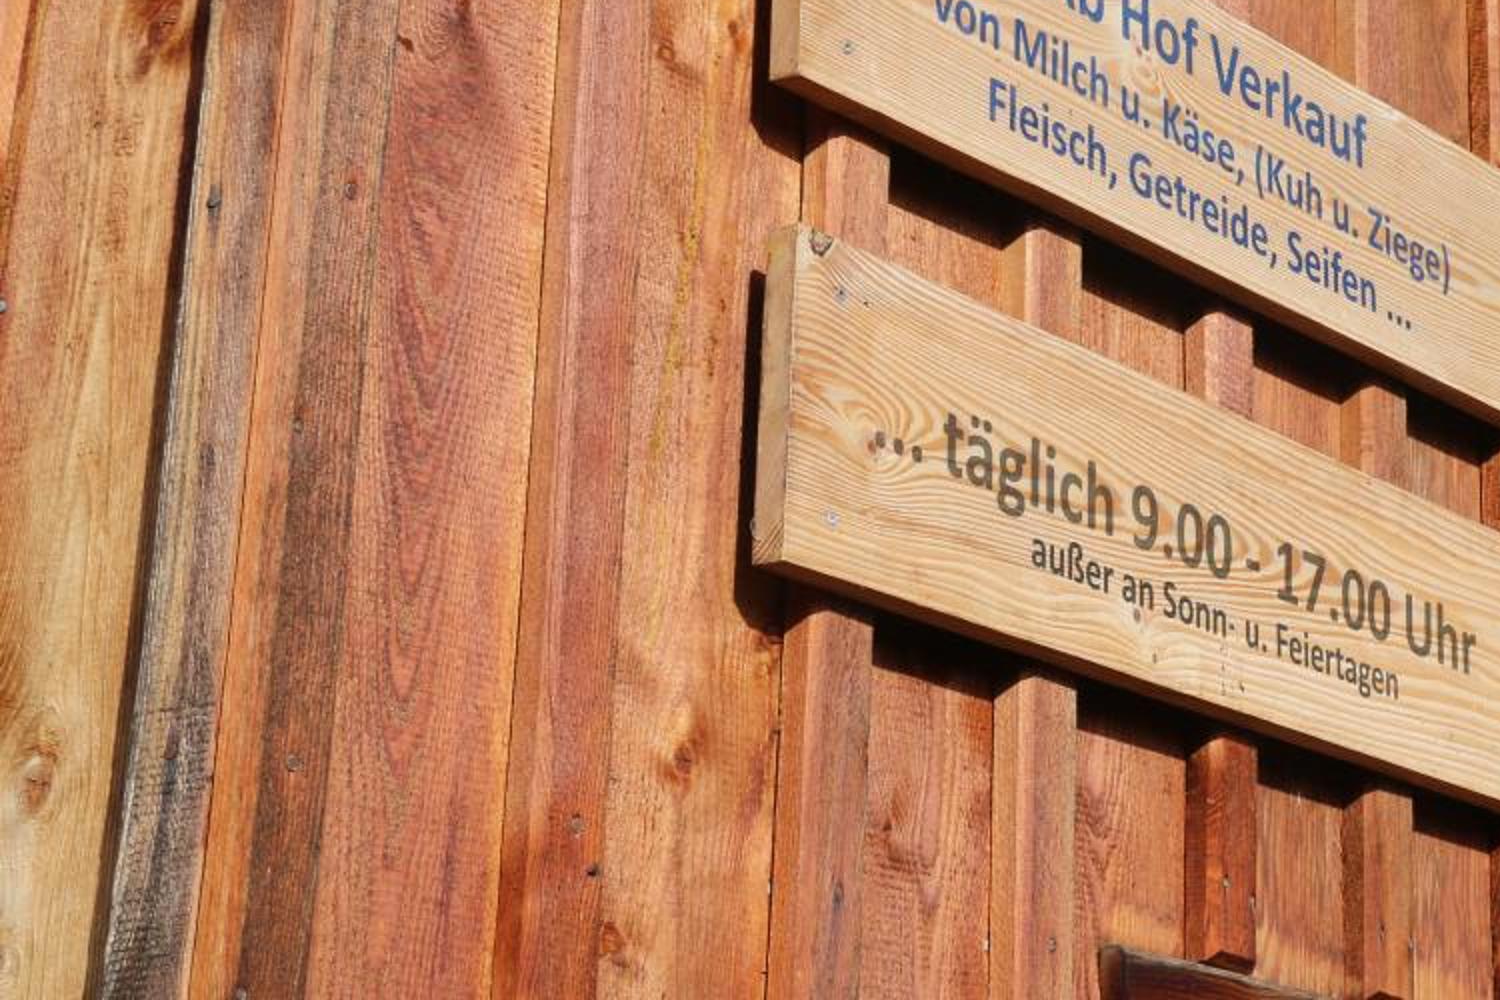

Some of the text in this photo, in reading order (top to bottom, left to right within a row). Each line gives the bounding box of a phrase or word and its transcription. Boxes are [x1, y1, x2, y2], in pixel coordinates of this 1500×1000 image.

[988, 77, 1117, 191] Fleisch,
[1129, 152, 1278, 269] Getreide,
[1287, 232, 1377, 313] Seifen
[1013, 18, 1109, 107] Milch
[1121, 98, 1151, 129] u.
[1163, 98, 1244, 187] Käse,
[1254, 144, 1324, 221] (Kuh
[1333, 199, 1359, 239] u.
[1368, 206, 1453, 296] Ziege)
[1212, 34, 1368, 169] Verkauf
[943, 411, 1115, 537] täglich
[1132, 484, 1233, 579] 9.00
[1275, 541, 1392, 642] 17.00
[1405, 593, 1477, 675] Uhr
[1030, 536, 1400, 700] außer an Sonn- u. Feiertagen
